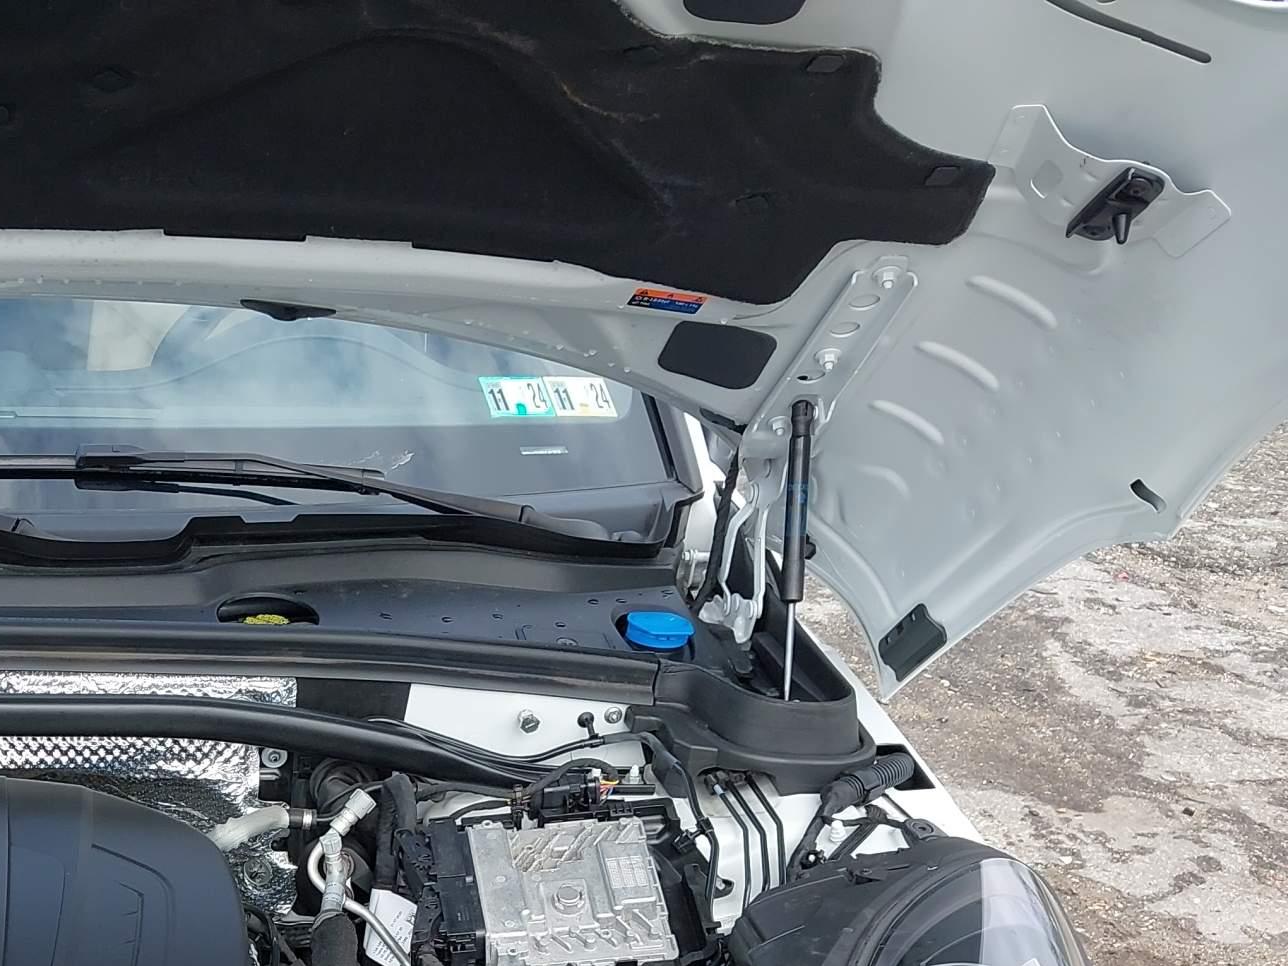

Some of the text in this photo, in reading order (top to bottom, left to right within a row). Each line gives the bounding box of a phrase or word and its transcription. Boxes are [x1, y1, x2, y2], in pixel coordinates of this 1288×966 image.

[488, 383, 548, 411] 11 24
[554, 383, 611, 410] 11 24
